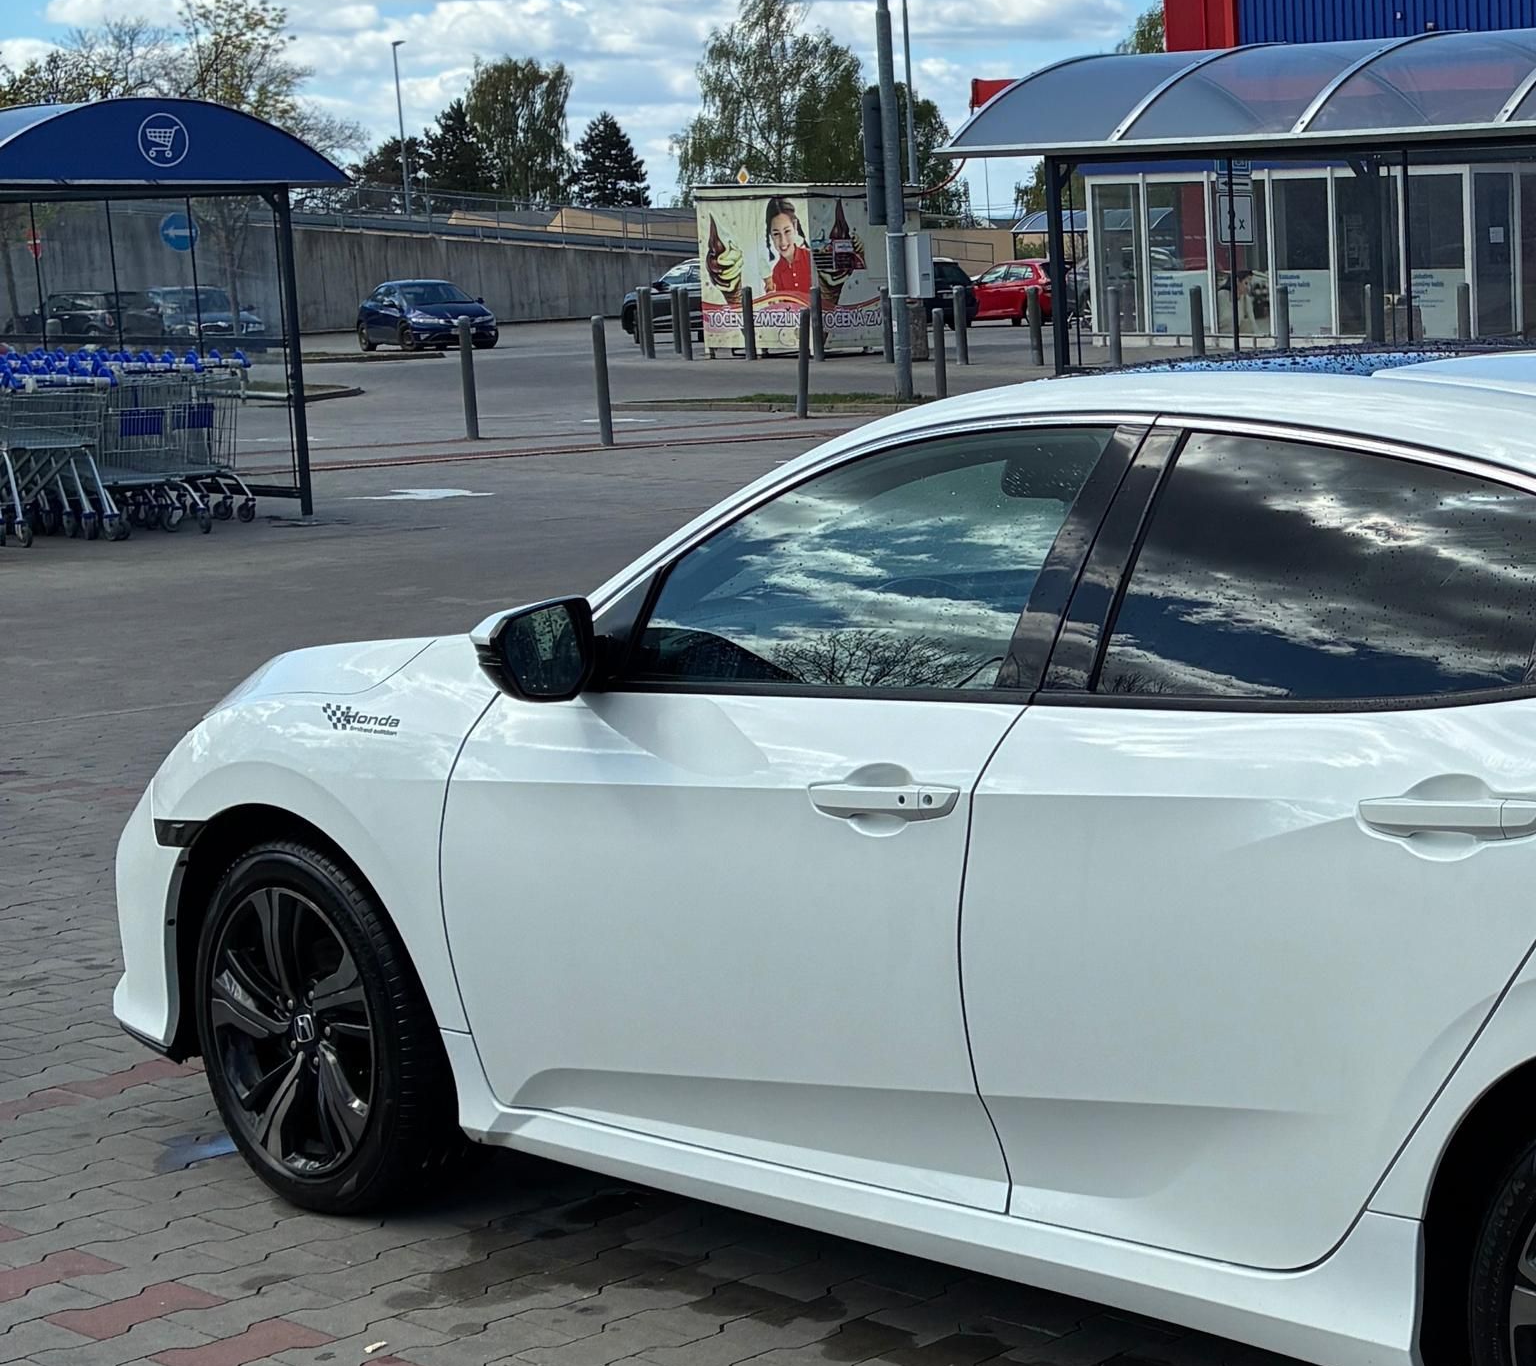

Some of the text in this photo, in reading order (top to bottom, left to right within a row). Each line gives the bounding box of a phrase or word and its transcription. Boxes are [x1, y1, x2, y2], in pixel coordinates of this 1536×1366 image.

[709, 308, 801, 328] TOČEN ZMRZLIN
[822, 306, 863, 328] OČENÁ
[343, 710, 400, 727] Honda
